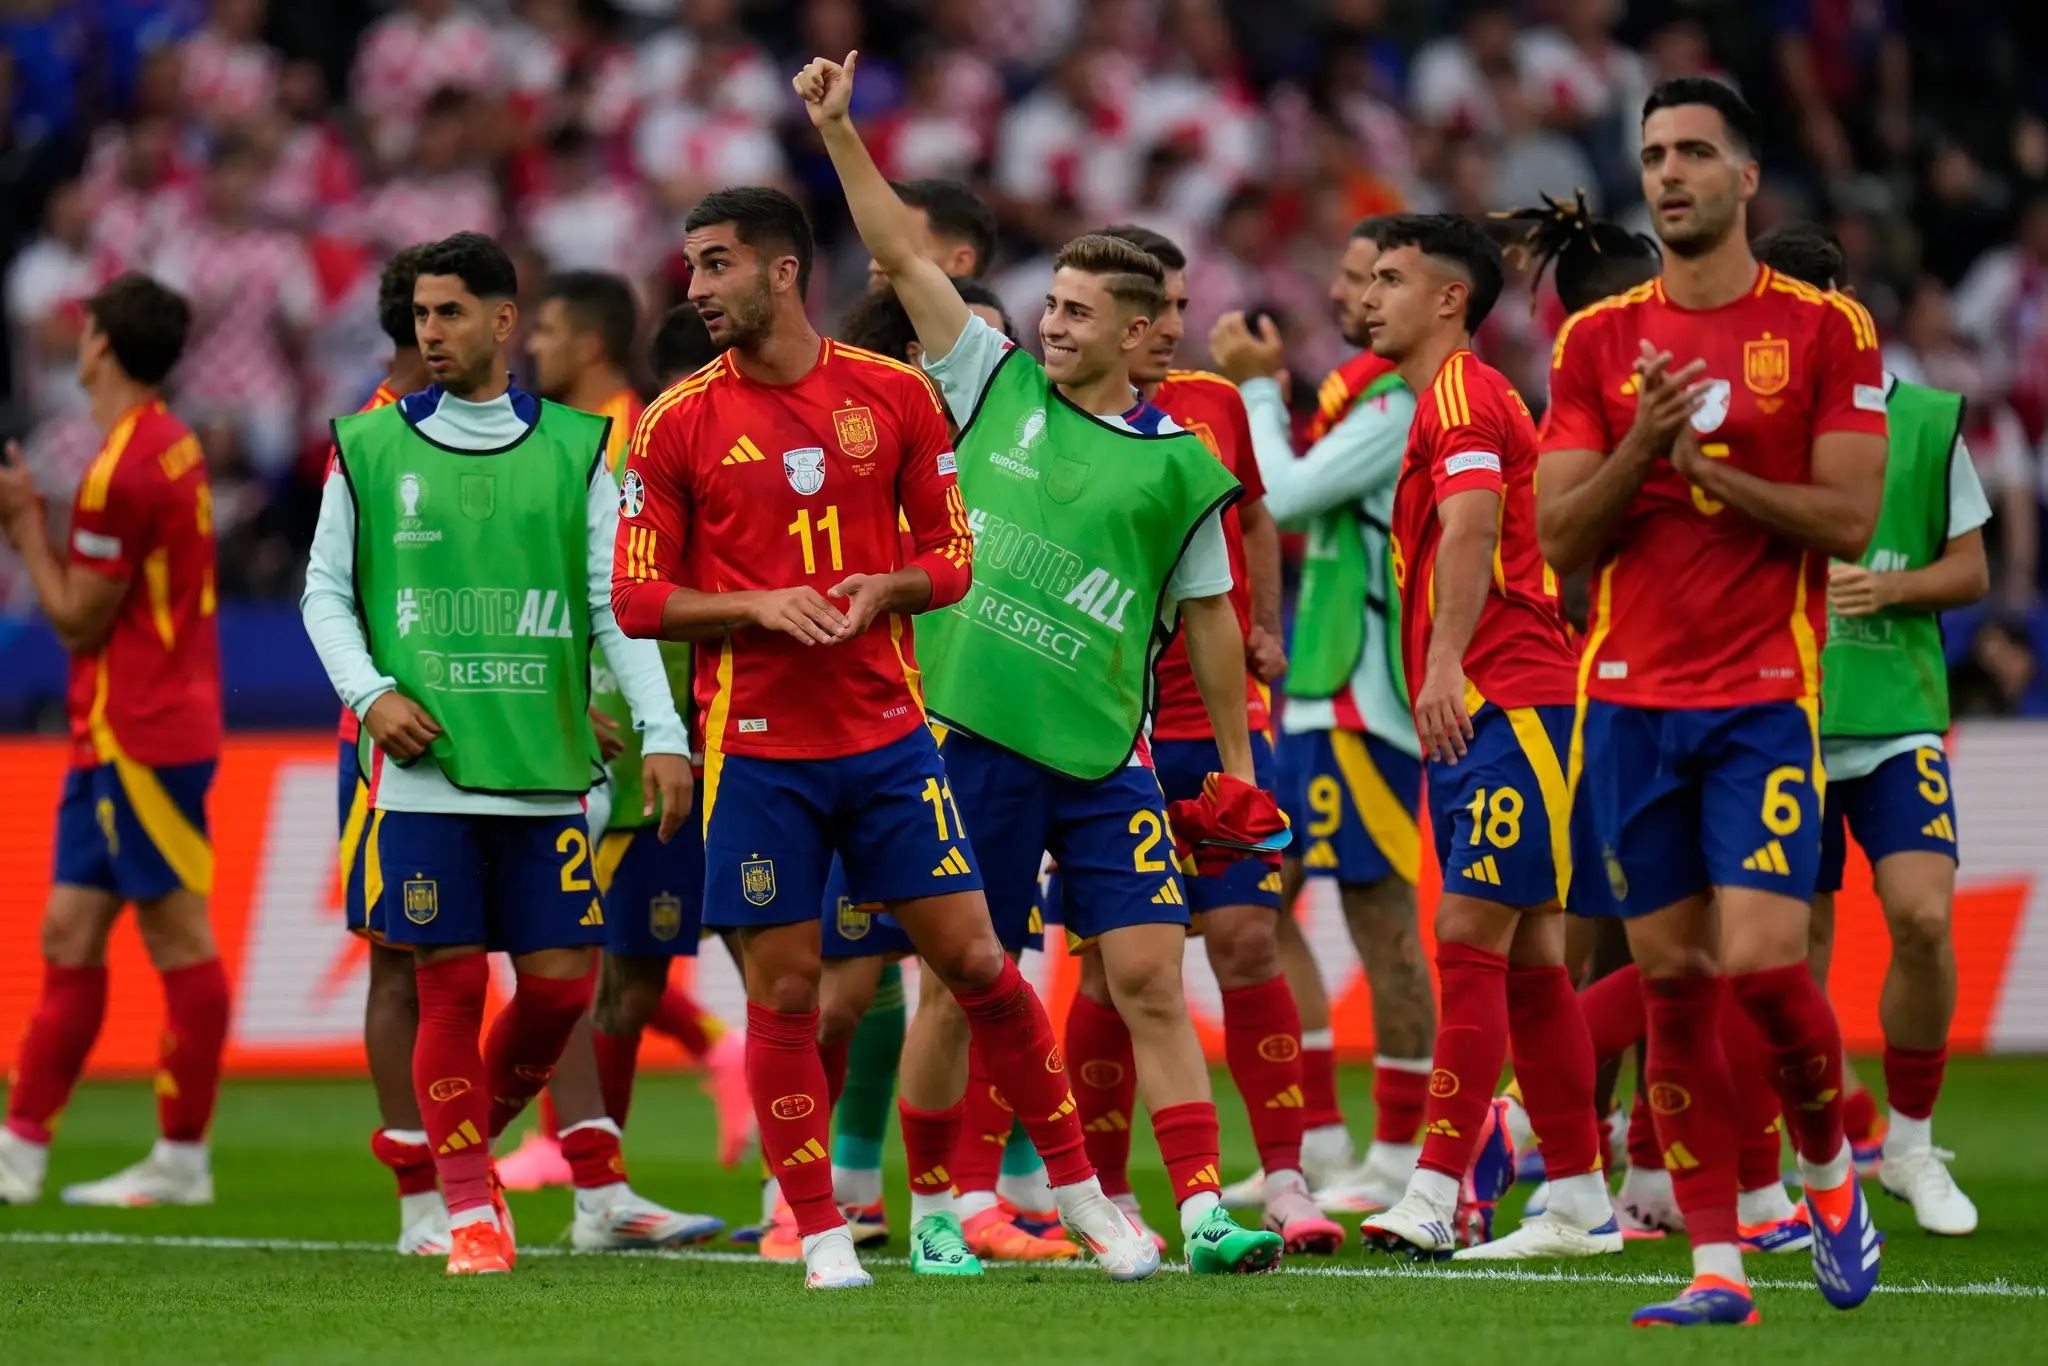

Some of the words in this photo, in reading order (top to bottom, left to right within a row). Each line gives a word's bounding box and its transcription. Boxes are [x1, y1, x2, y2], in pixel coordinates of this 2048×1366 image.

[989, 451, 1040, 480] EURO2024
[788, 505, 844, 574] 11
[396, 587, 573, 639] #FOOTBALL
[978, 595, 1087, 661] RESPECT
[450, 661, 547, 686] RESPECT
[1308, 775, 1341, 837] 9
[1761, 765, 1805, 836] 6
[1916, 746, 1949, 805] 5
[922, 777, 966, 841] 11
[1466, 786, 1524, 849] 18
[556, 827, 591, 892] 2
